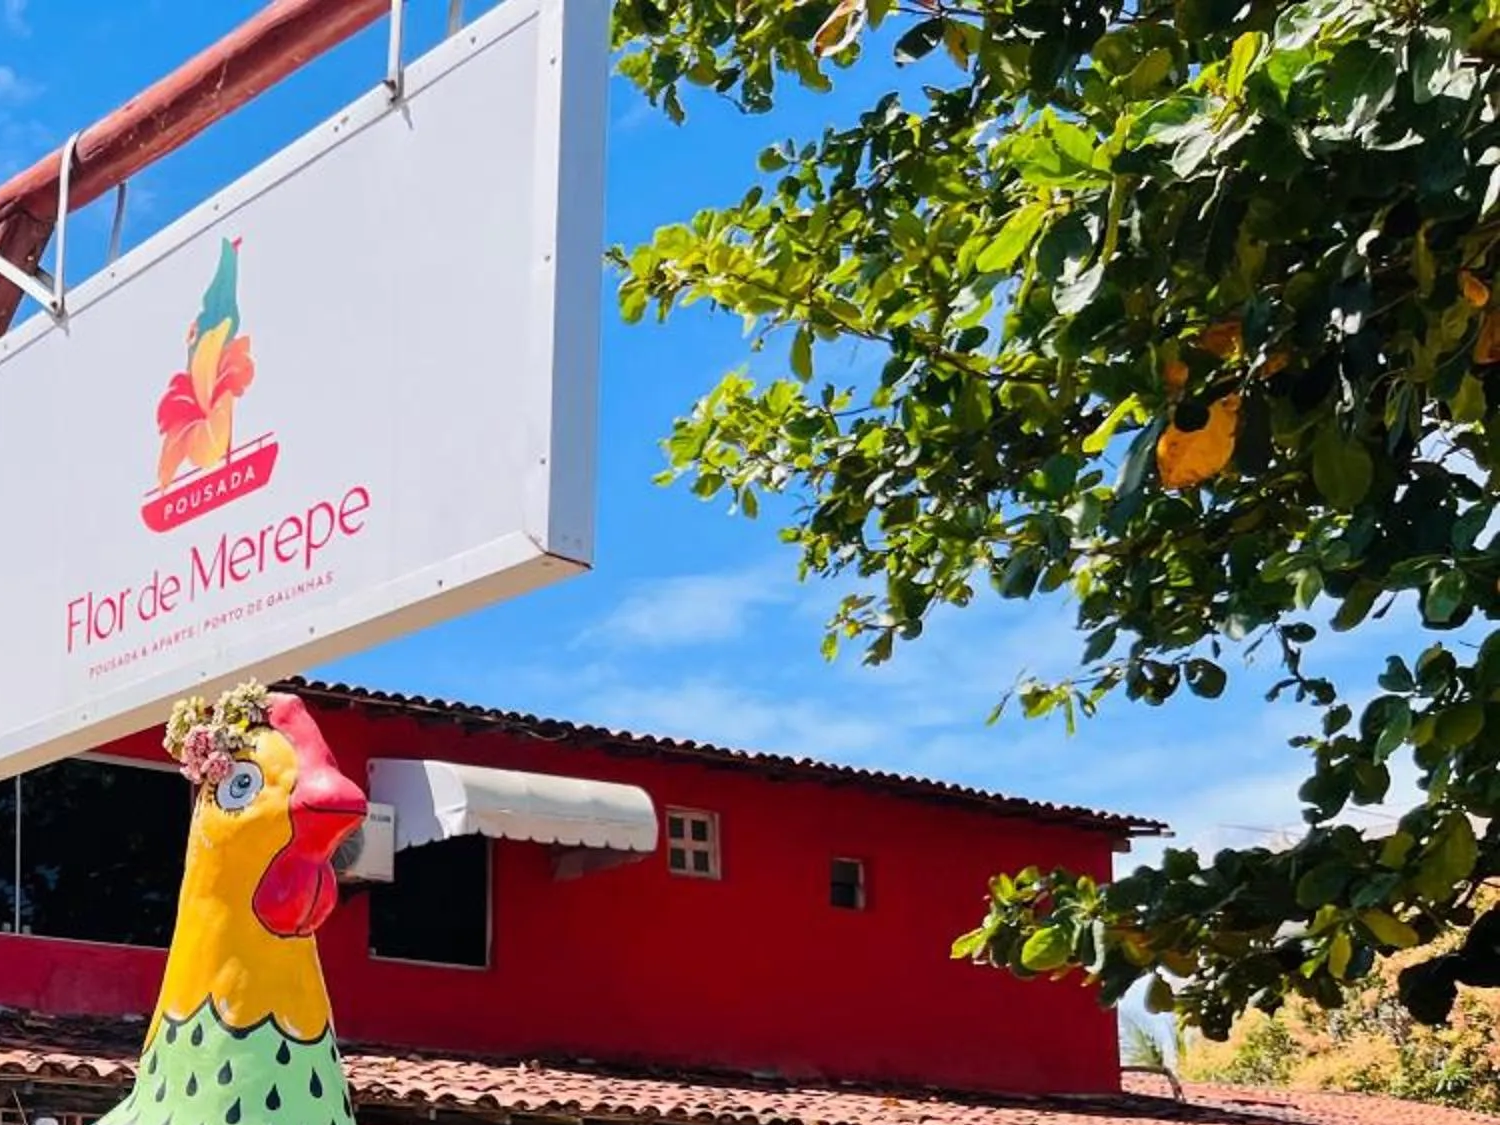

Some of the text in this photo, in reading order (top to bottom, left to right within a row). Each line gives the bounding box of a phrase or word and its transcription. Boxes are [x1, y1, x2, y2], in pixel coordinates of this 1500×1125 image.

[163, 464, 256, 520] POUSADA
[67, 486, 370, 654] Flor de Merepe
[89, 649, 137, 679] POUSADA
[152, 627, 195, 653] APARTS
[203, 606, 243, 632] PORTO
[248, 598, 262, 614] DE
[266, 570, 335, 607] GALINHAS
